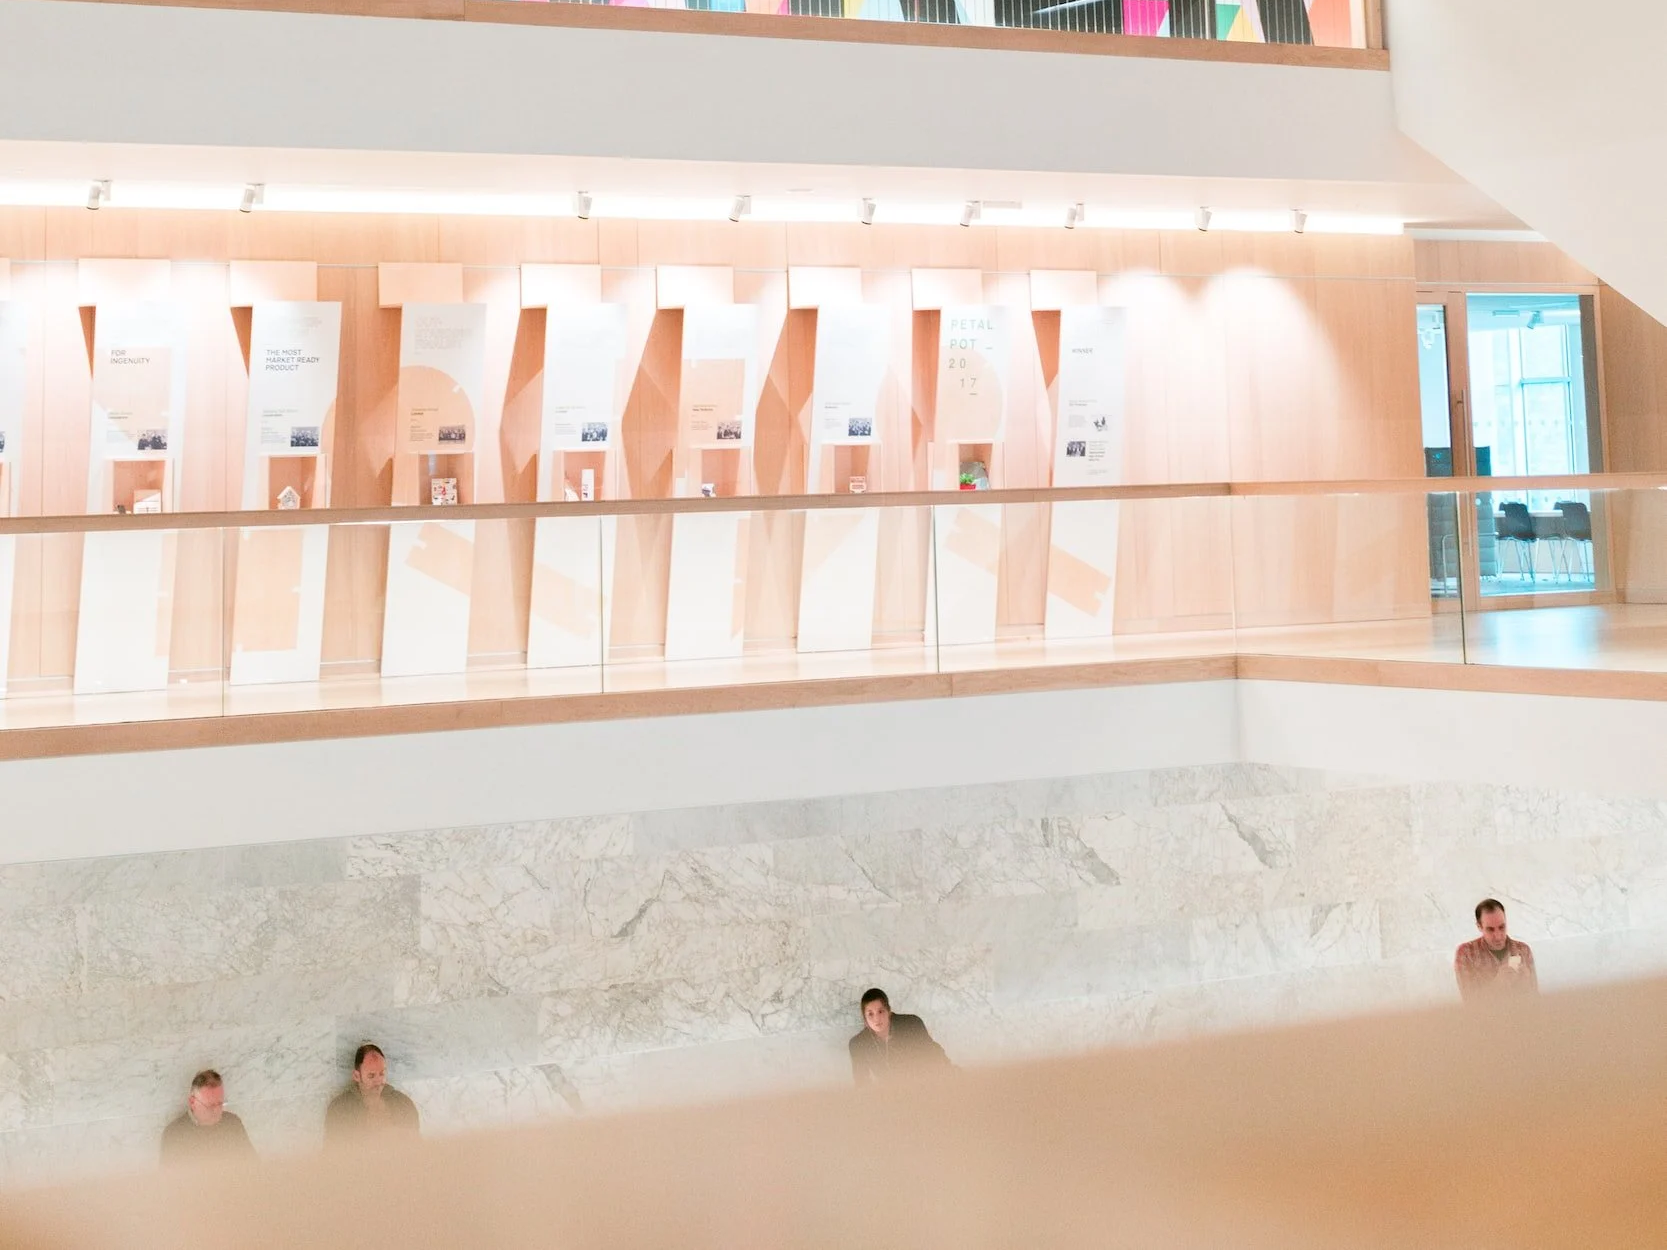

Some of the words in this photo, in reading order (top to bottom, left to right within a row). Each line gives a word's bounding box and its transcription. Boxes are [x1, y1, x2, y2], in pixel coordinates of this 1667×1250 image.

[951, 318, 993, 331] PETAL
[949, 338, 977, 351] POT
[111, 349, 127, 357] FOR
[110, 357, 151, 365] INGENUITY
[265, 356, 295, 364] MARKET
[296, 356, 320, 364] READY
[948, 358, 967, 369] 20
[960, 377, 977, 389] 17
